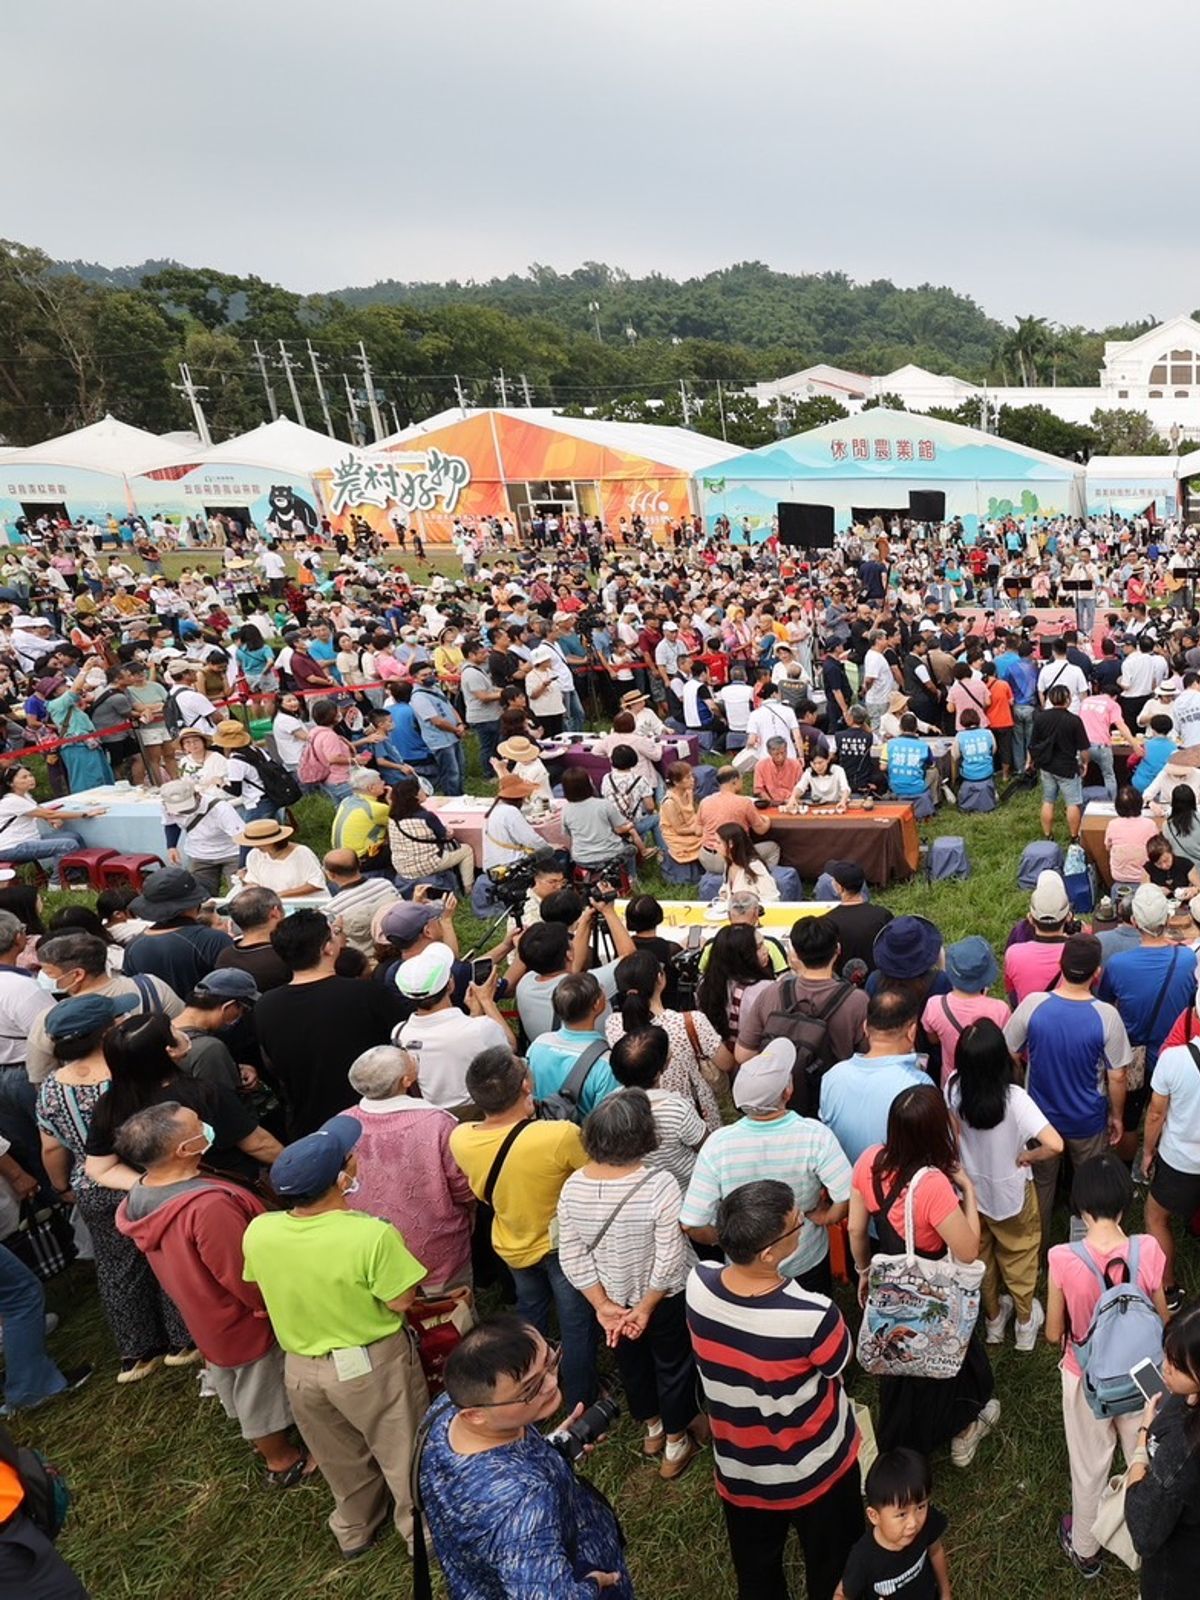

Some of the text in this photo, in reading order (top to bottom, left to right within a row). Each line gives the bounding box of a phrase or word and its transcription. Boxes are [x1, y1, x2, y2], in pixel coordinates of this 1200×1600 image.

[831, 439, 935, 460] 休閒農業館
[333, 450, 467, 511] 農村好物
[927, 1356, 961, 1367] PENAN
